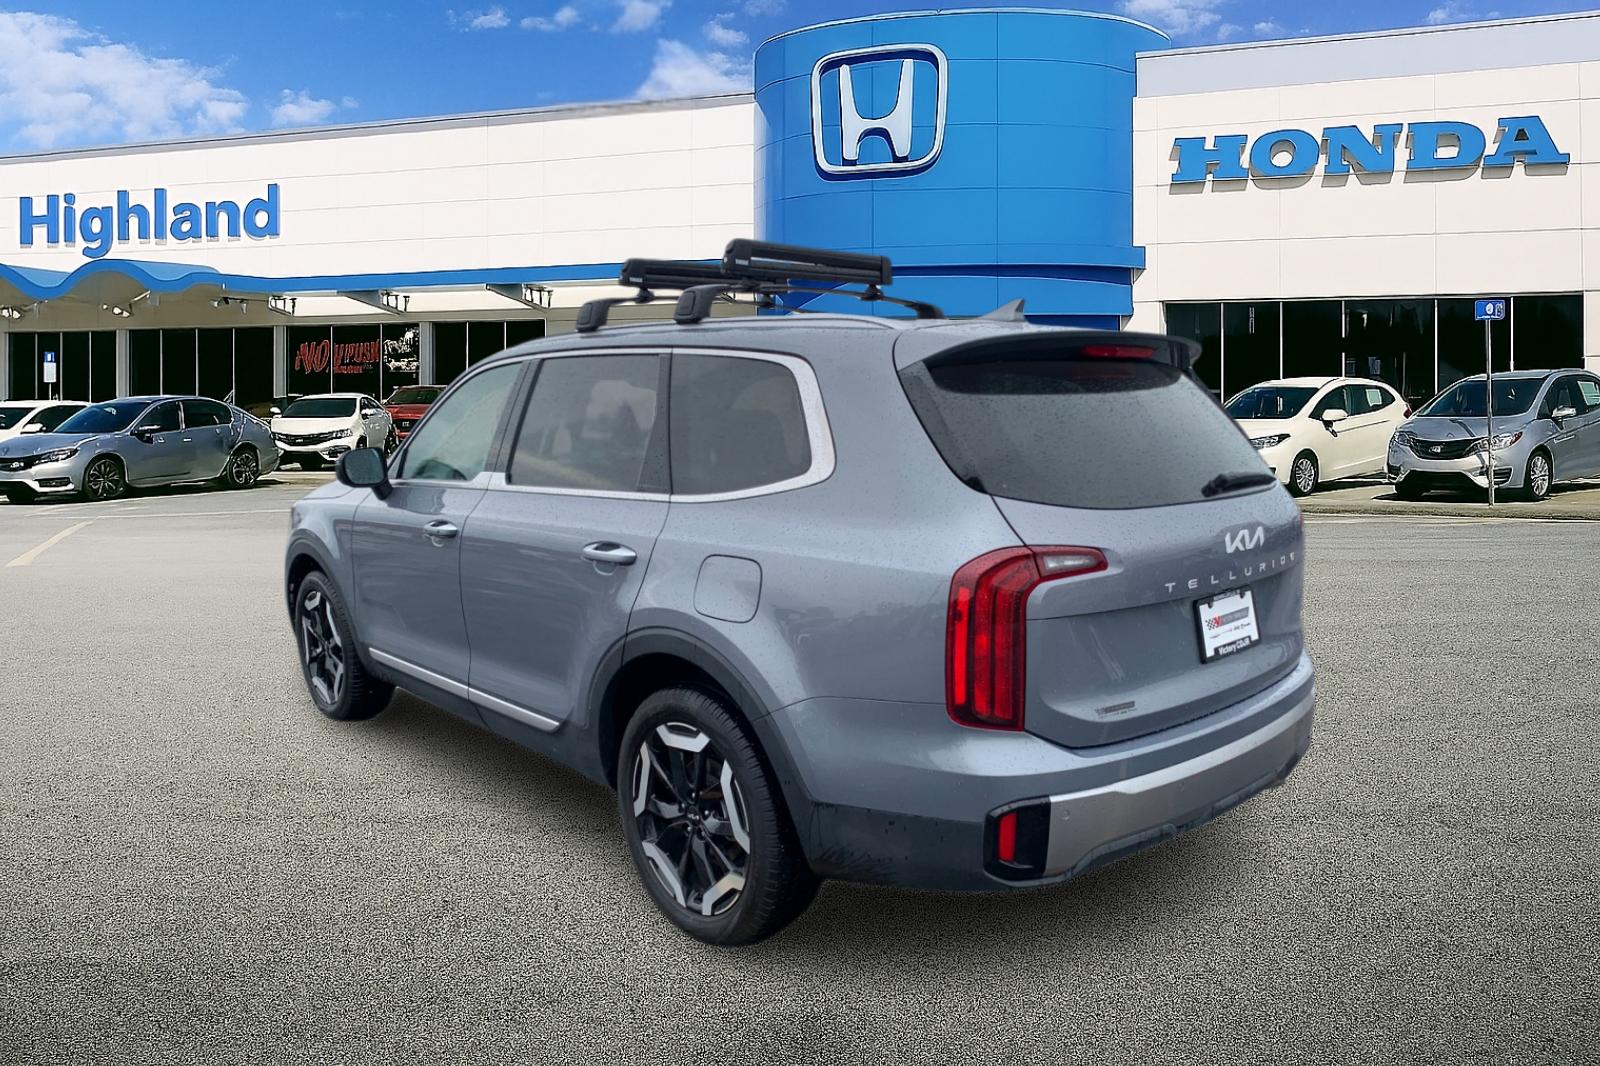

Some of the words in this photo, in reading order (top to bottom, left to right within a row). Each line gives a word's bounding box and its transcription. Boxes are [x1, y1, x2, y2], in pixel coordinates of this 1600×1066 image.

[1170, 115, 1571, 184] HONDA
[19, 183, 280, 258] Highland
[1164, 551, 1295, 593] TELLURIDE
